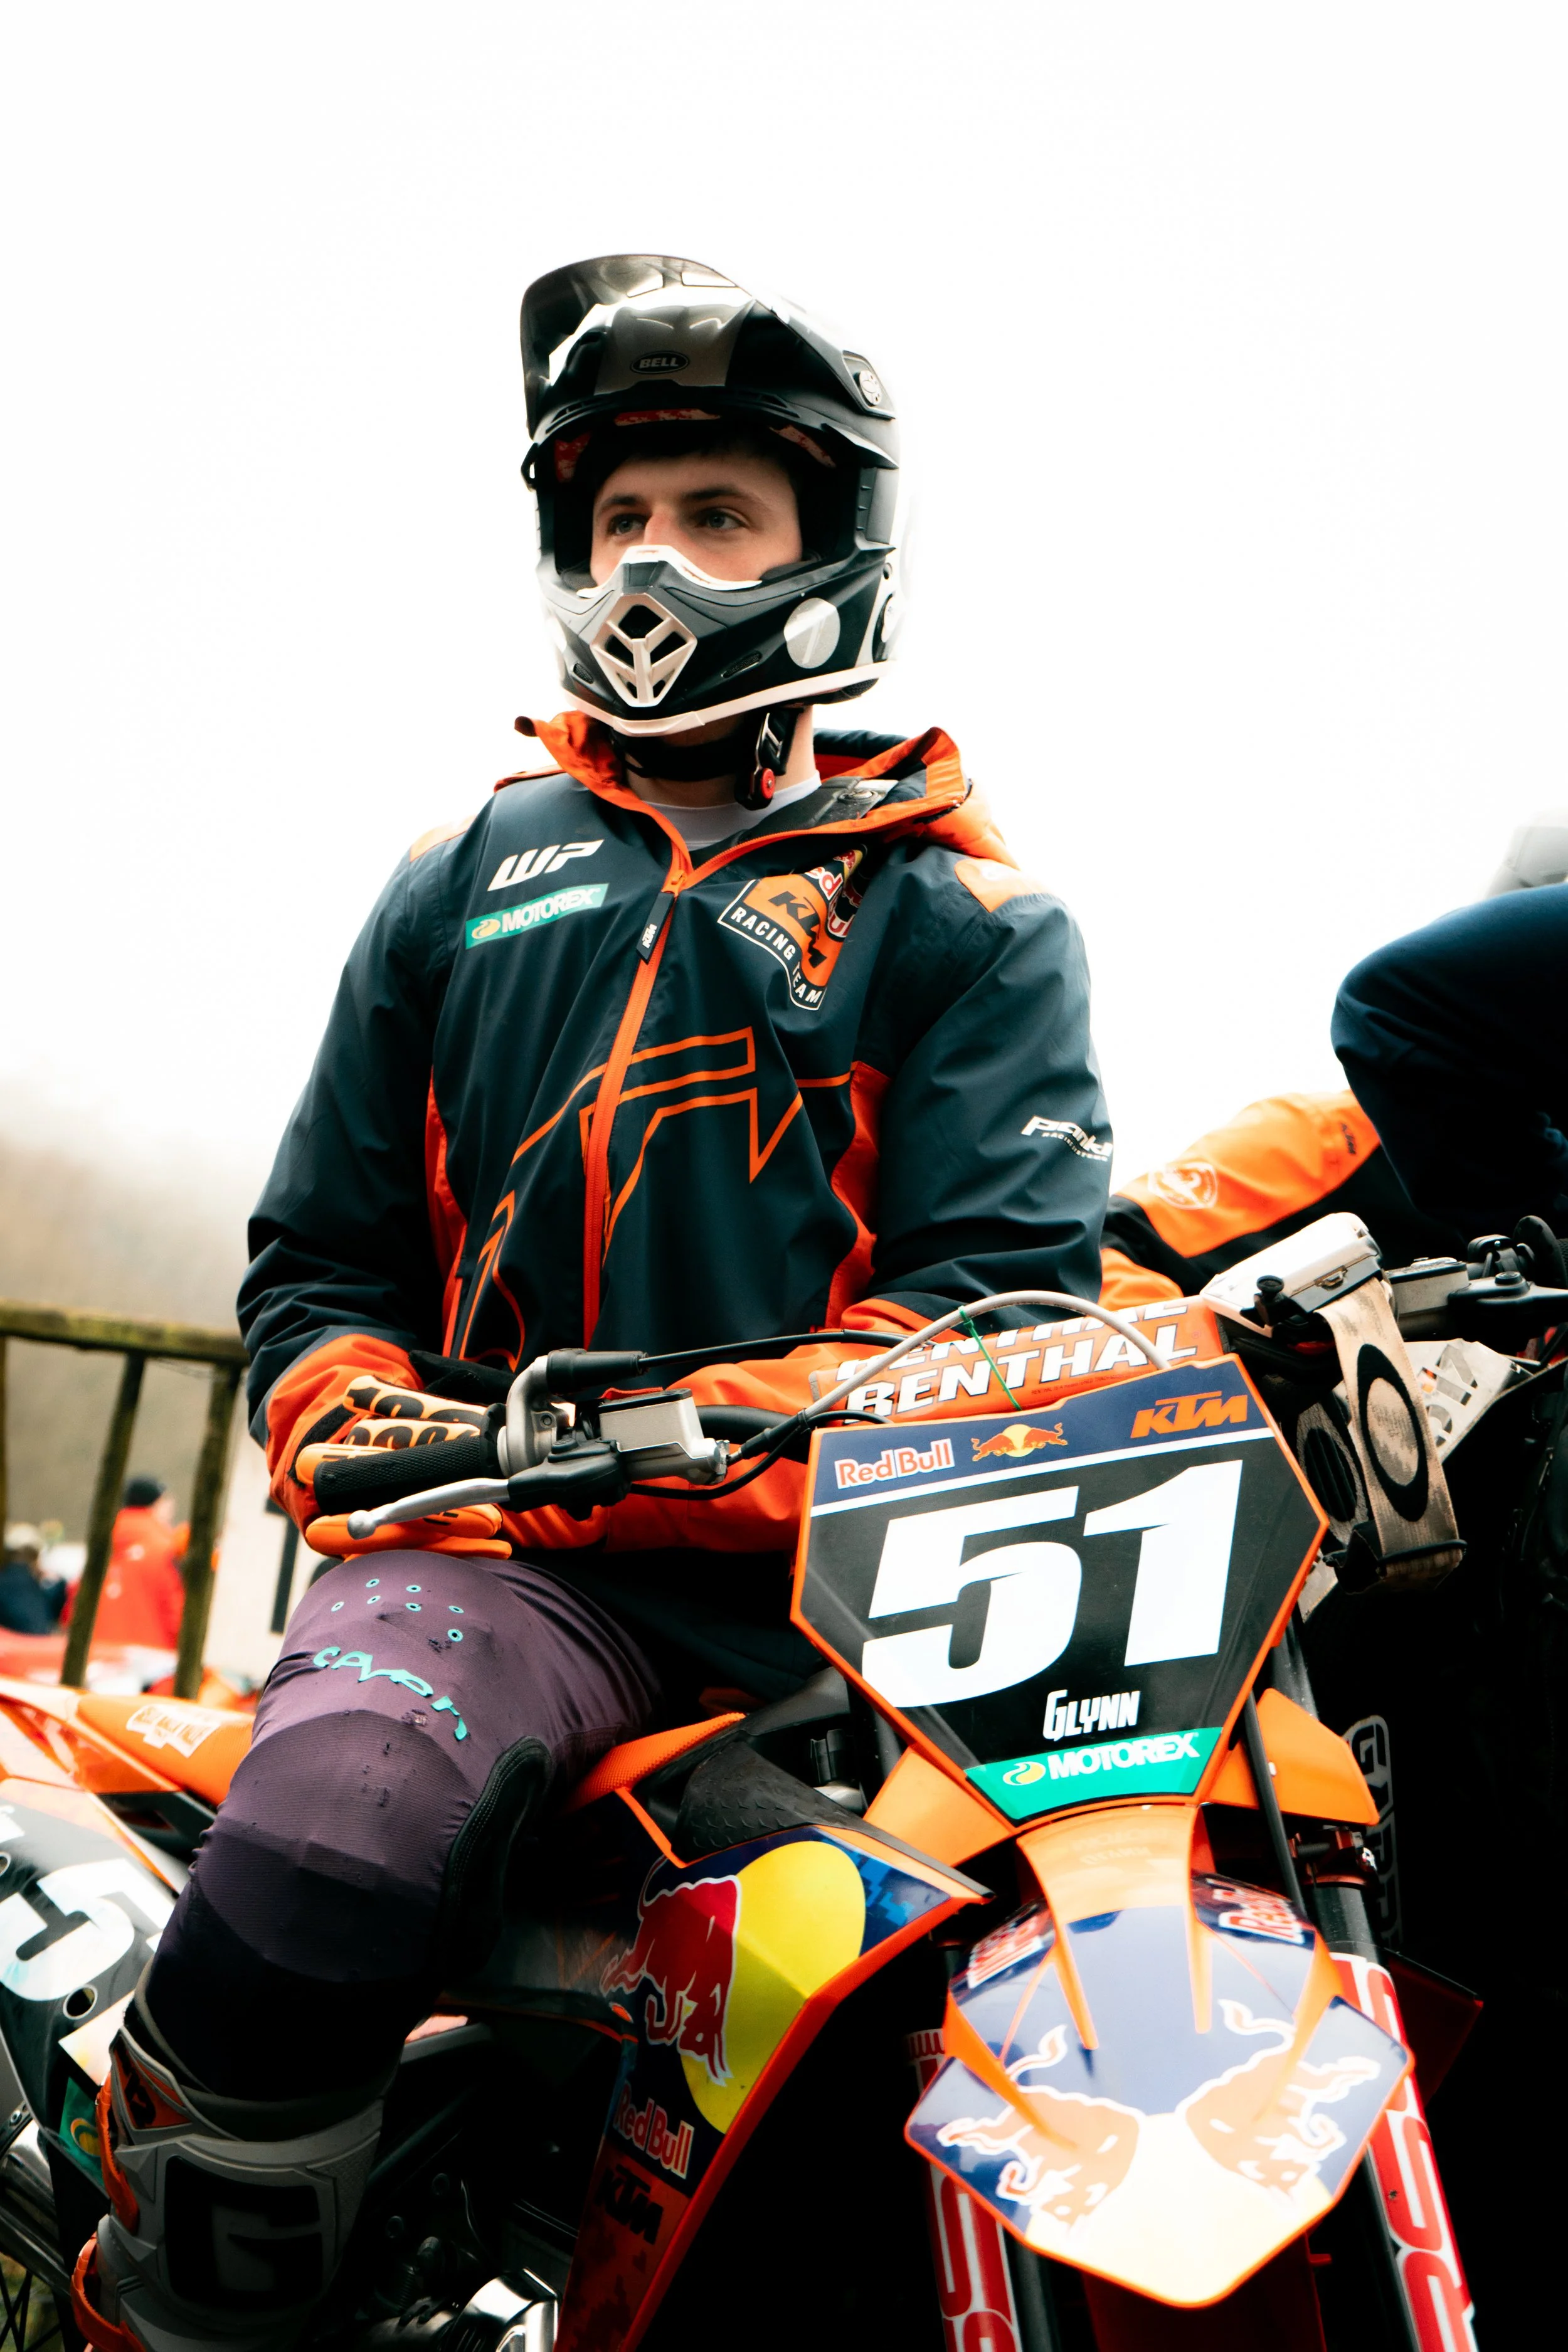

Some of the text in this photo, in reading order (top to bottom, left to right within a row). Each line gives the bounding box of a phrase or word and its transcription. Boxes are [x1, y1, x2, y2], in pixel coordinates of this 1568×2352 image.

[639, 358, 679, 369] BELL
[487, 839, 605, 891] WP
[502, 888, 596, 933] MOTOREX
[641, 923, 658, 949] KTM
[730, 906, 823, 1004] RACING TEAM
[844, 1322, 1197, 1424] RENTHAL
[1131, 1391, 1248, 1439] KTM
[835, 1439, 955, 1489] Red Bull
[862, 1459, 1243, 1708] 51
[1042, 1689, 1141, 1742] GLYNN
[1047, 1732, 1200, 1780] MOTOREX
[613, 2080, 695, 2180] Red Bull
[595, 2163, 664, 2245] KTM
